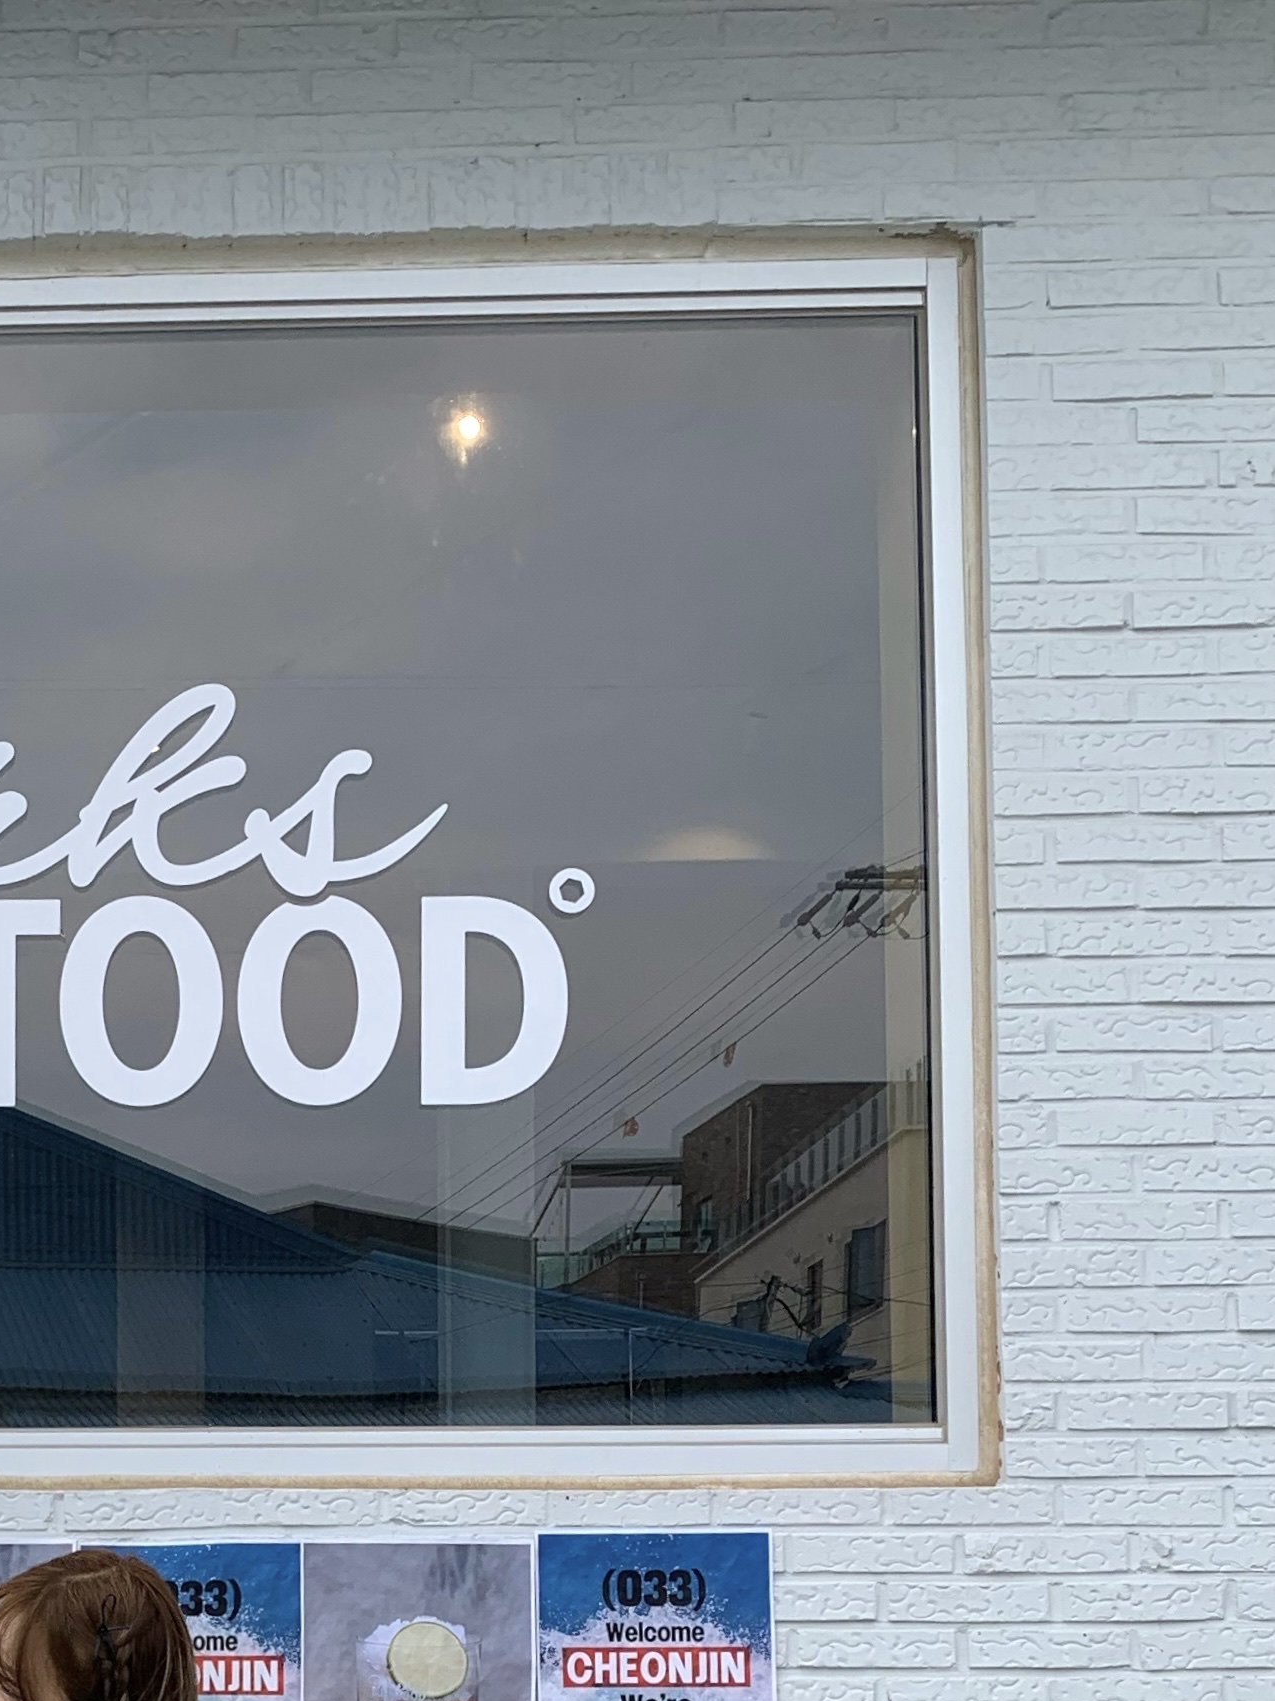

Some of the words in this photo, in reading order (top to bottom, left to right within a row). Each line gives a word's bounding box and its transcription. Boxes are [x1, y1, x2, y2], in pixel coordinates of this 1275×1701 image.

[165, 1578, 242, 1621] 33)
[601, 1568, 706, 1612] (033)
[606, 1622, 705, 1643] Welcome
[196, 1659, 279, 1692] NJIN
[566, 1651, 747, 1686] CHEONJIN
